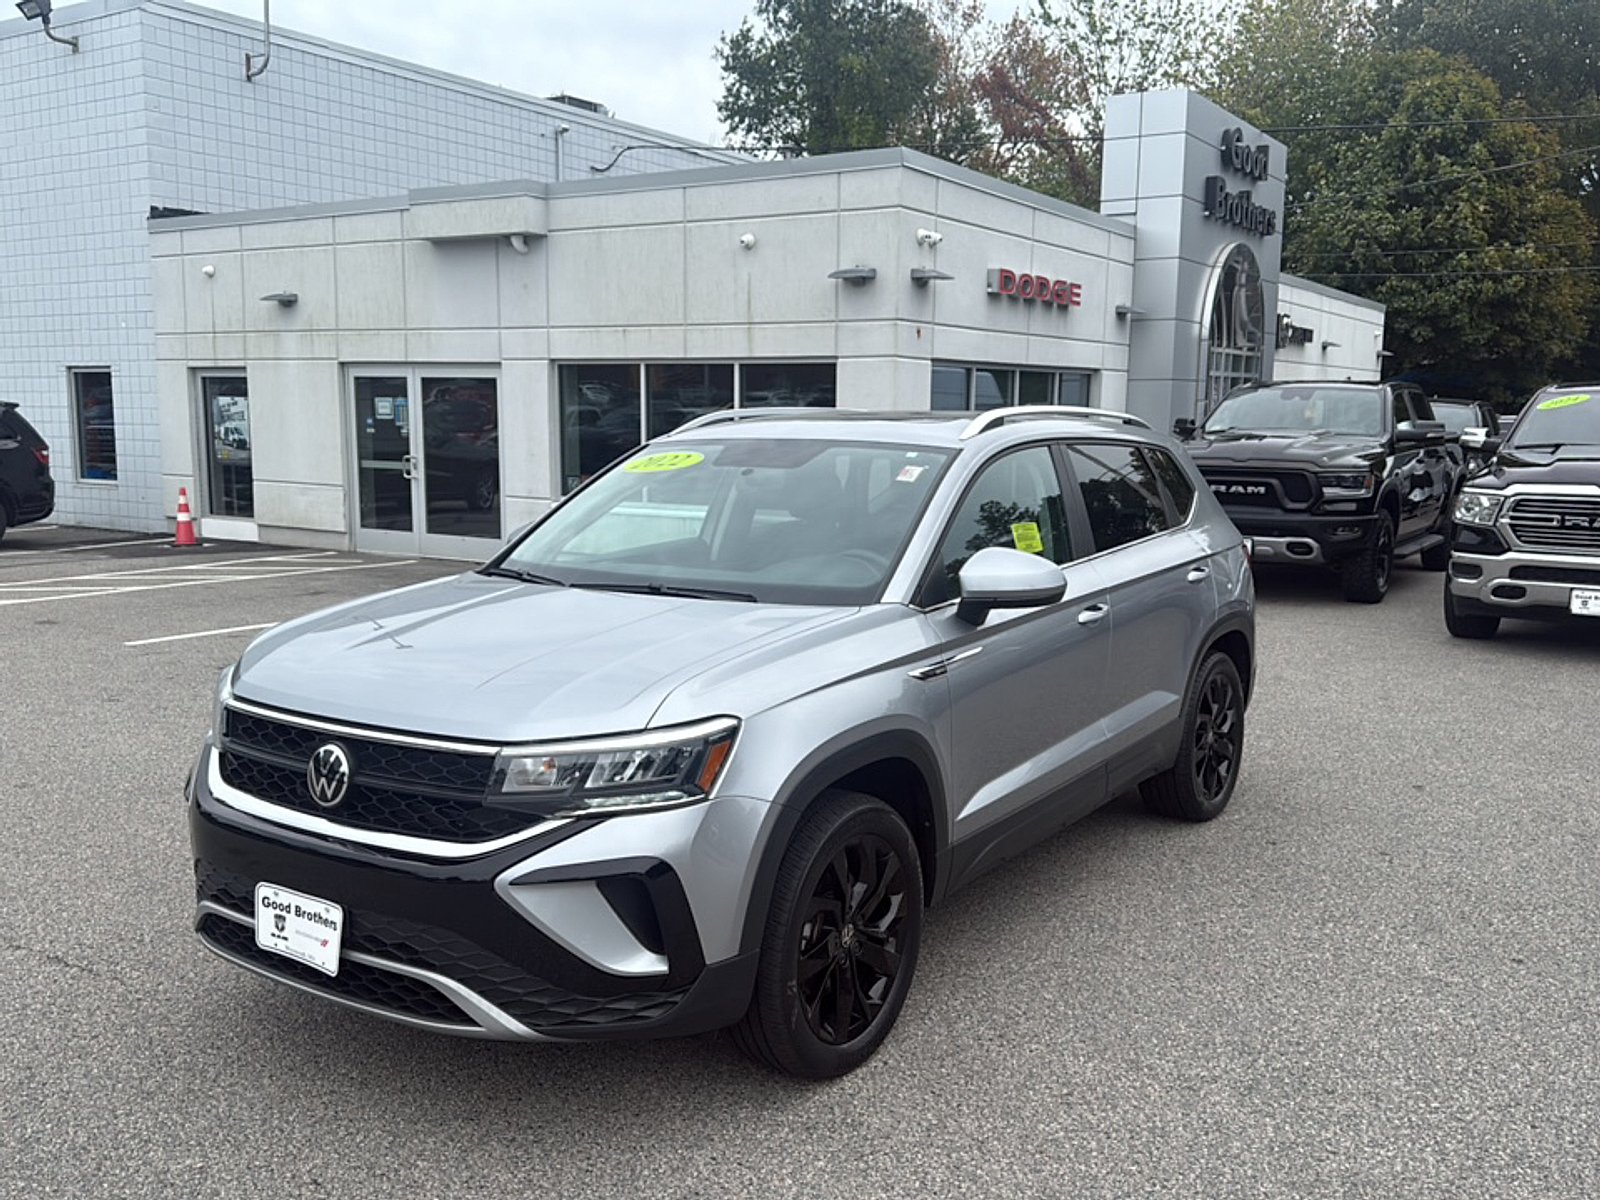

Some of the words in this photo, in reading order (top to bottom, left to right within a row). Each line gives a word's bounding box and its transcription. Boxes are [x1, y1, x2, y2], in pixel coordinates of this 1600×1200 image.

[1221, 127, 1269, 181] Good
[1204, 175, 1276, 236] Brothers
[998, 268, 1082, 307] DODGE
[1209, 484, 1266, 494] RAM
[261, 896, 292, 915] Good
[294, 904, 338, 931] Brothers
